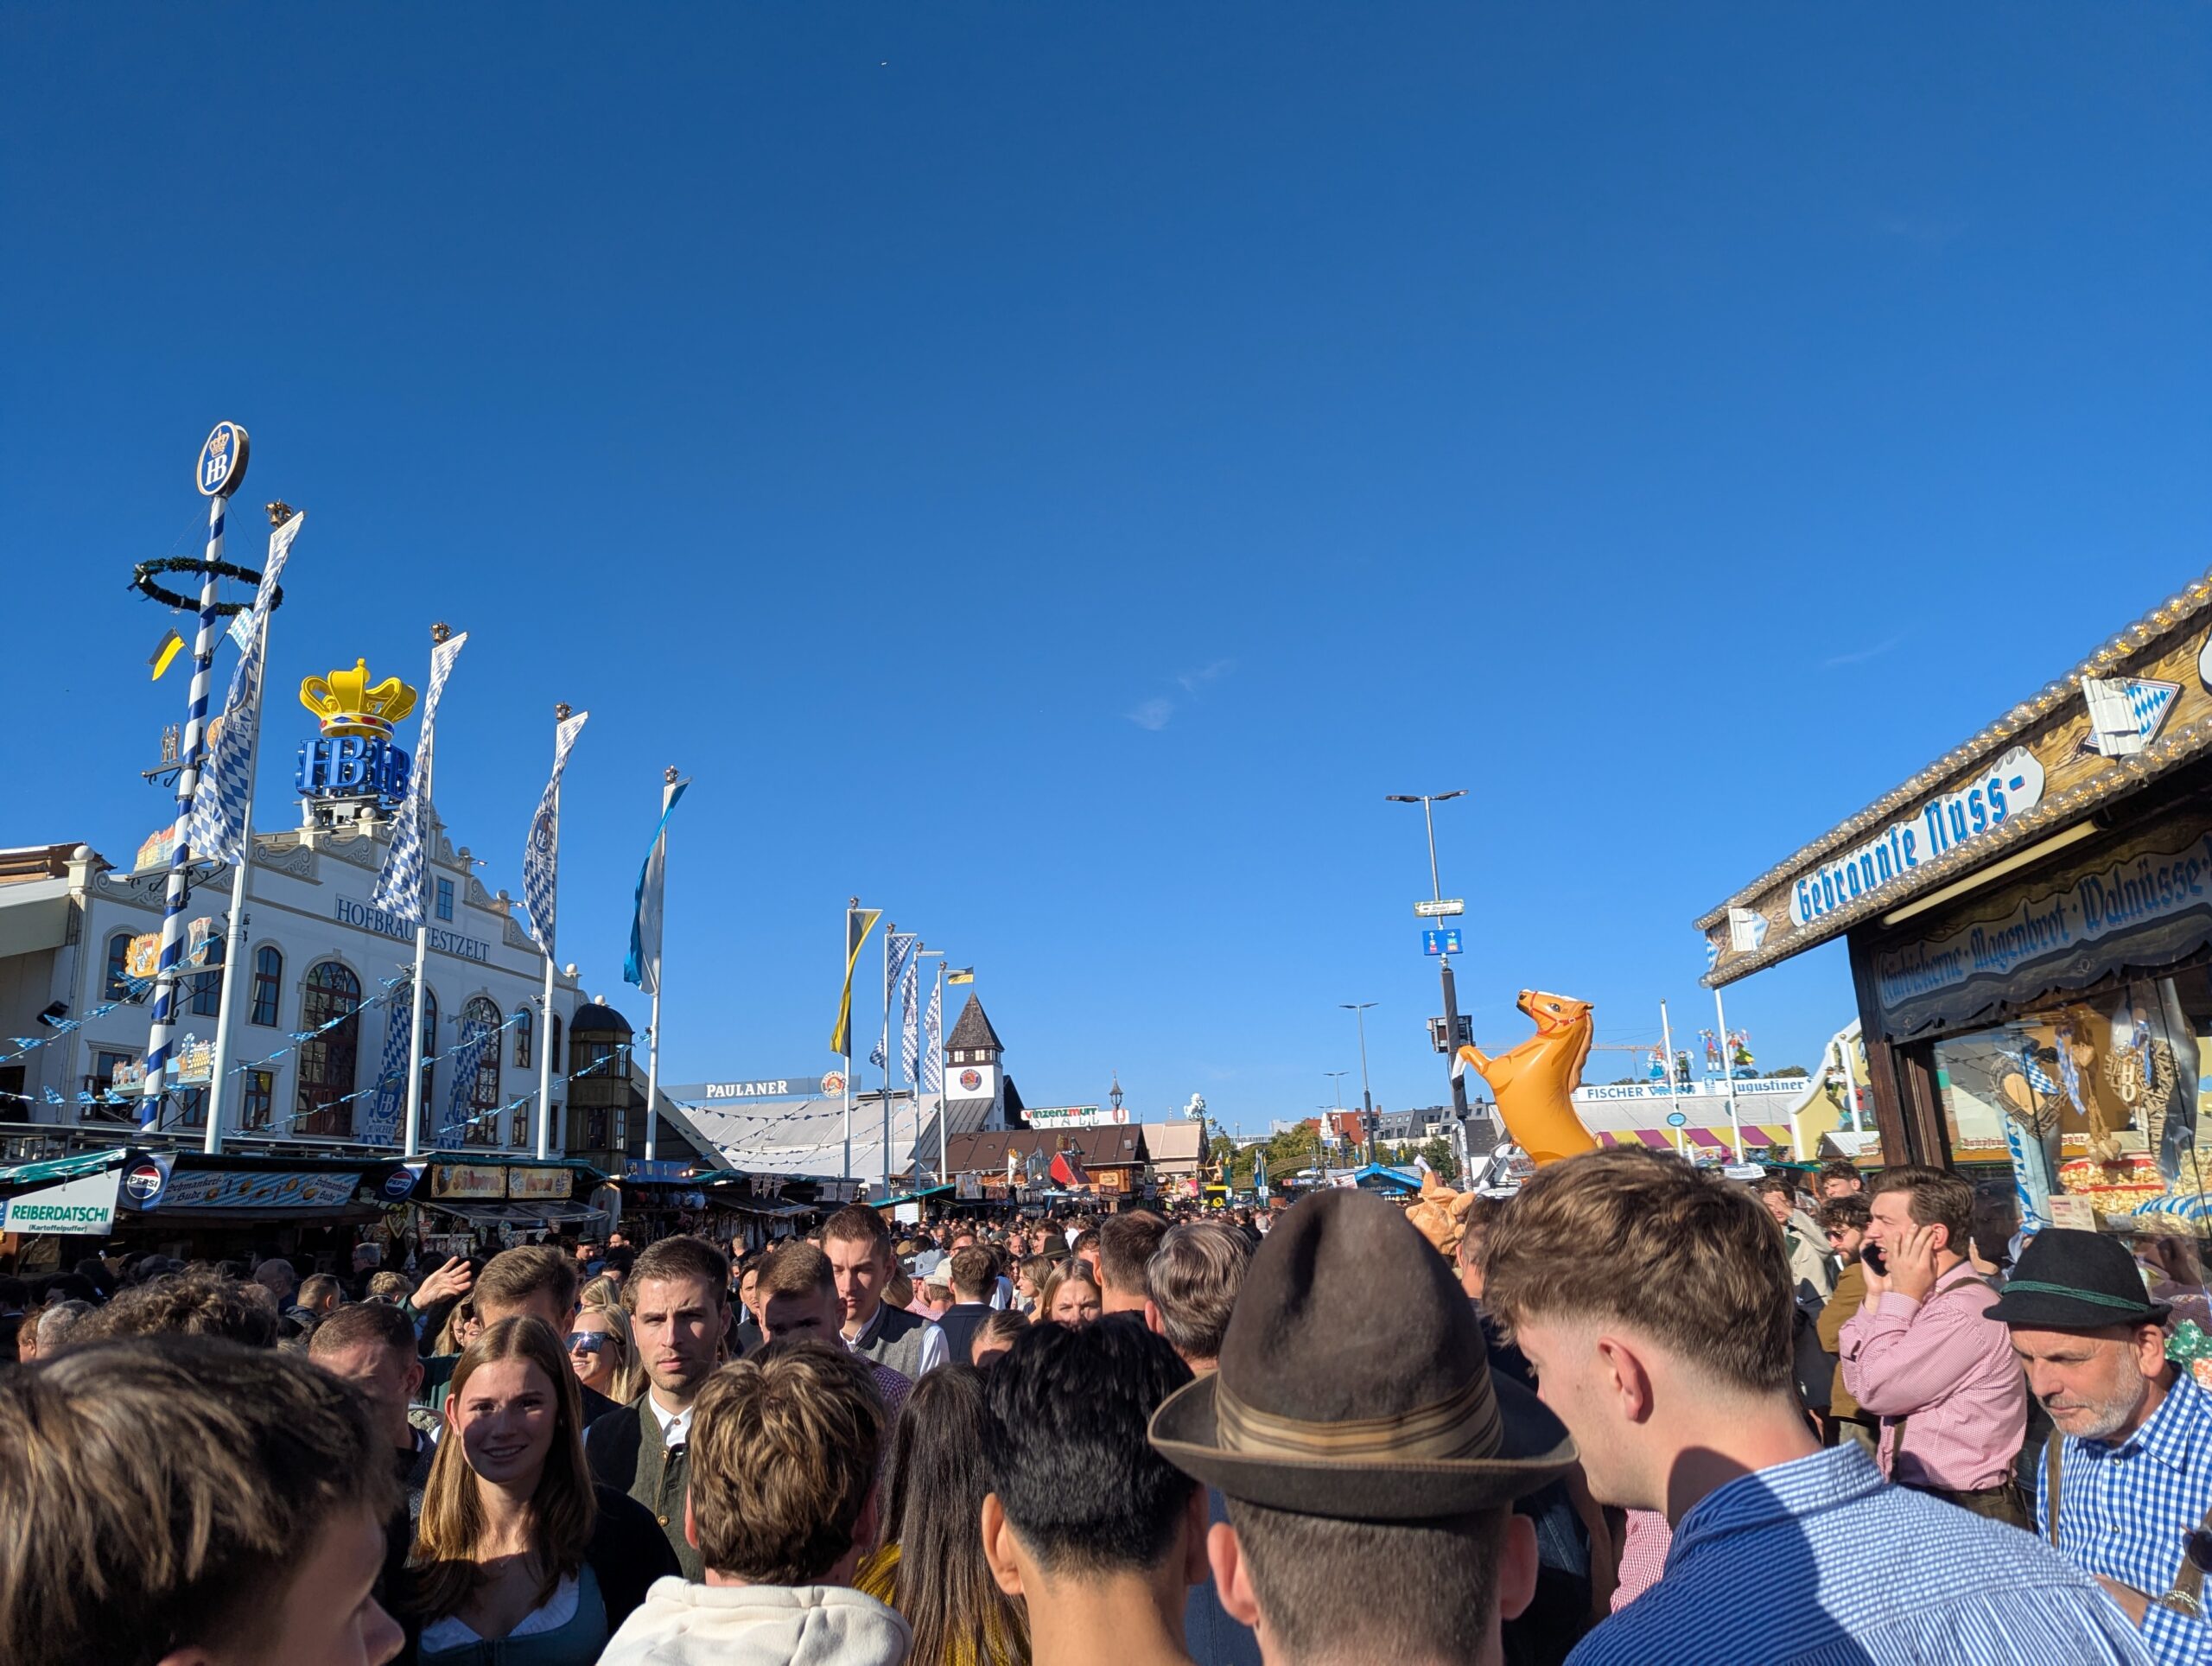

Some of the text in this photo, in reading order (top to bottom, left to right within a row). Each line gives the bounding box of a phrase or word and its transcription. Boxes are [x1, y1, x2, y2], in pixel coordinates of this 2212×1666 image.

[205, 454, 227, 486] HB
[296, 735, 367, 790] HB
[1797, 774, 2025, 922] Gebrannte Nuss-
[1970, 896, 2070, 972] Magenbrot
[2078, 856, 2203, 933] Walnüsse
[706, 1080, 788, 1098] PAULANER
[1587, 1087, 1643, 1098] FISCHER
[378, 1093, 395, 1113] HB
[1025, 1107, 1097, 1119] vinzenzmurr
[130, 1176, 158, 1188] PEPSI
[388, 1179, 410, 1188] PEPSI
[11, 1205, 110, 1222] REIBERDATSCHI
[29, 1224, 87, 1233] (Kartoffelpuffer)
